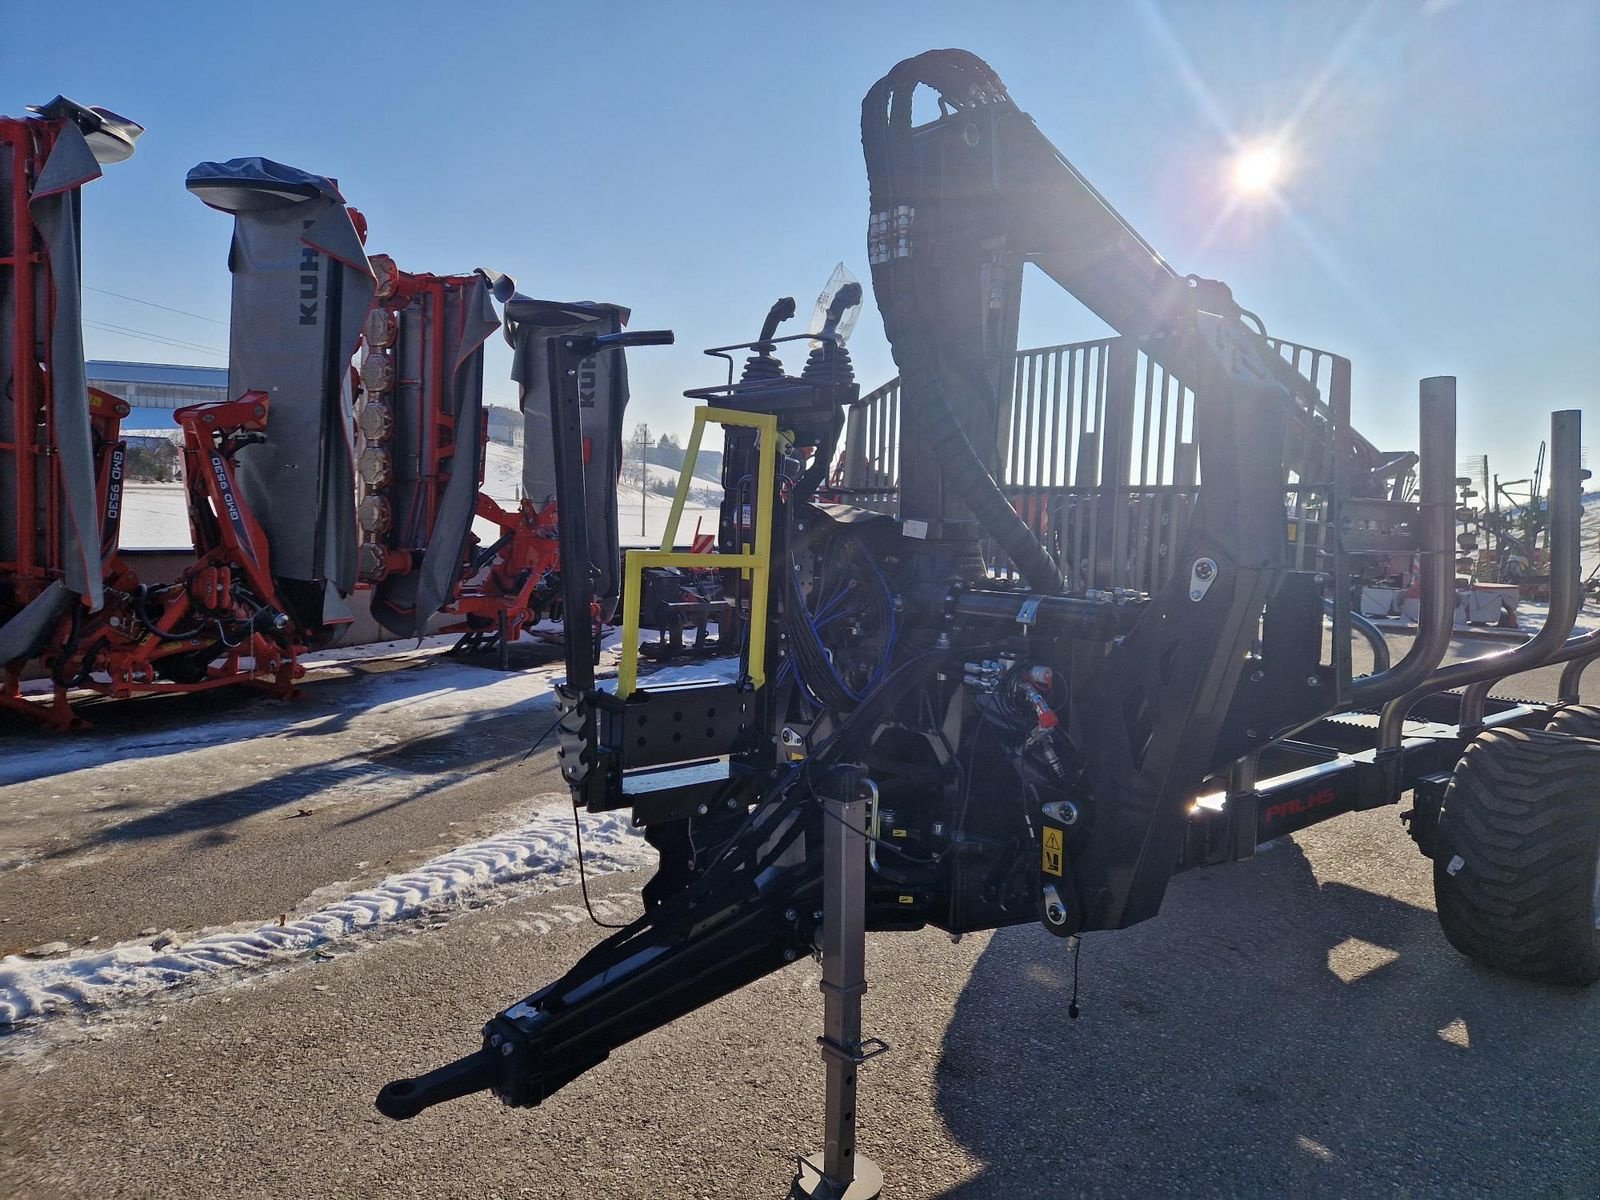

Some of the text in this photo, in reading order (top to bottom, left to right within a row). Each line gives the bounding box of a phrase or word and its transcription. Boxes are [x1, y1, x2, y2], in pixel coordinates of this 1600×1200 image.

[580, 332, 597, 408] KUH
[107, 451, 123, 518] GMD 9530
[212, 457, 239, 520] GMD 9530
